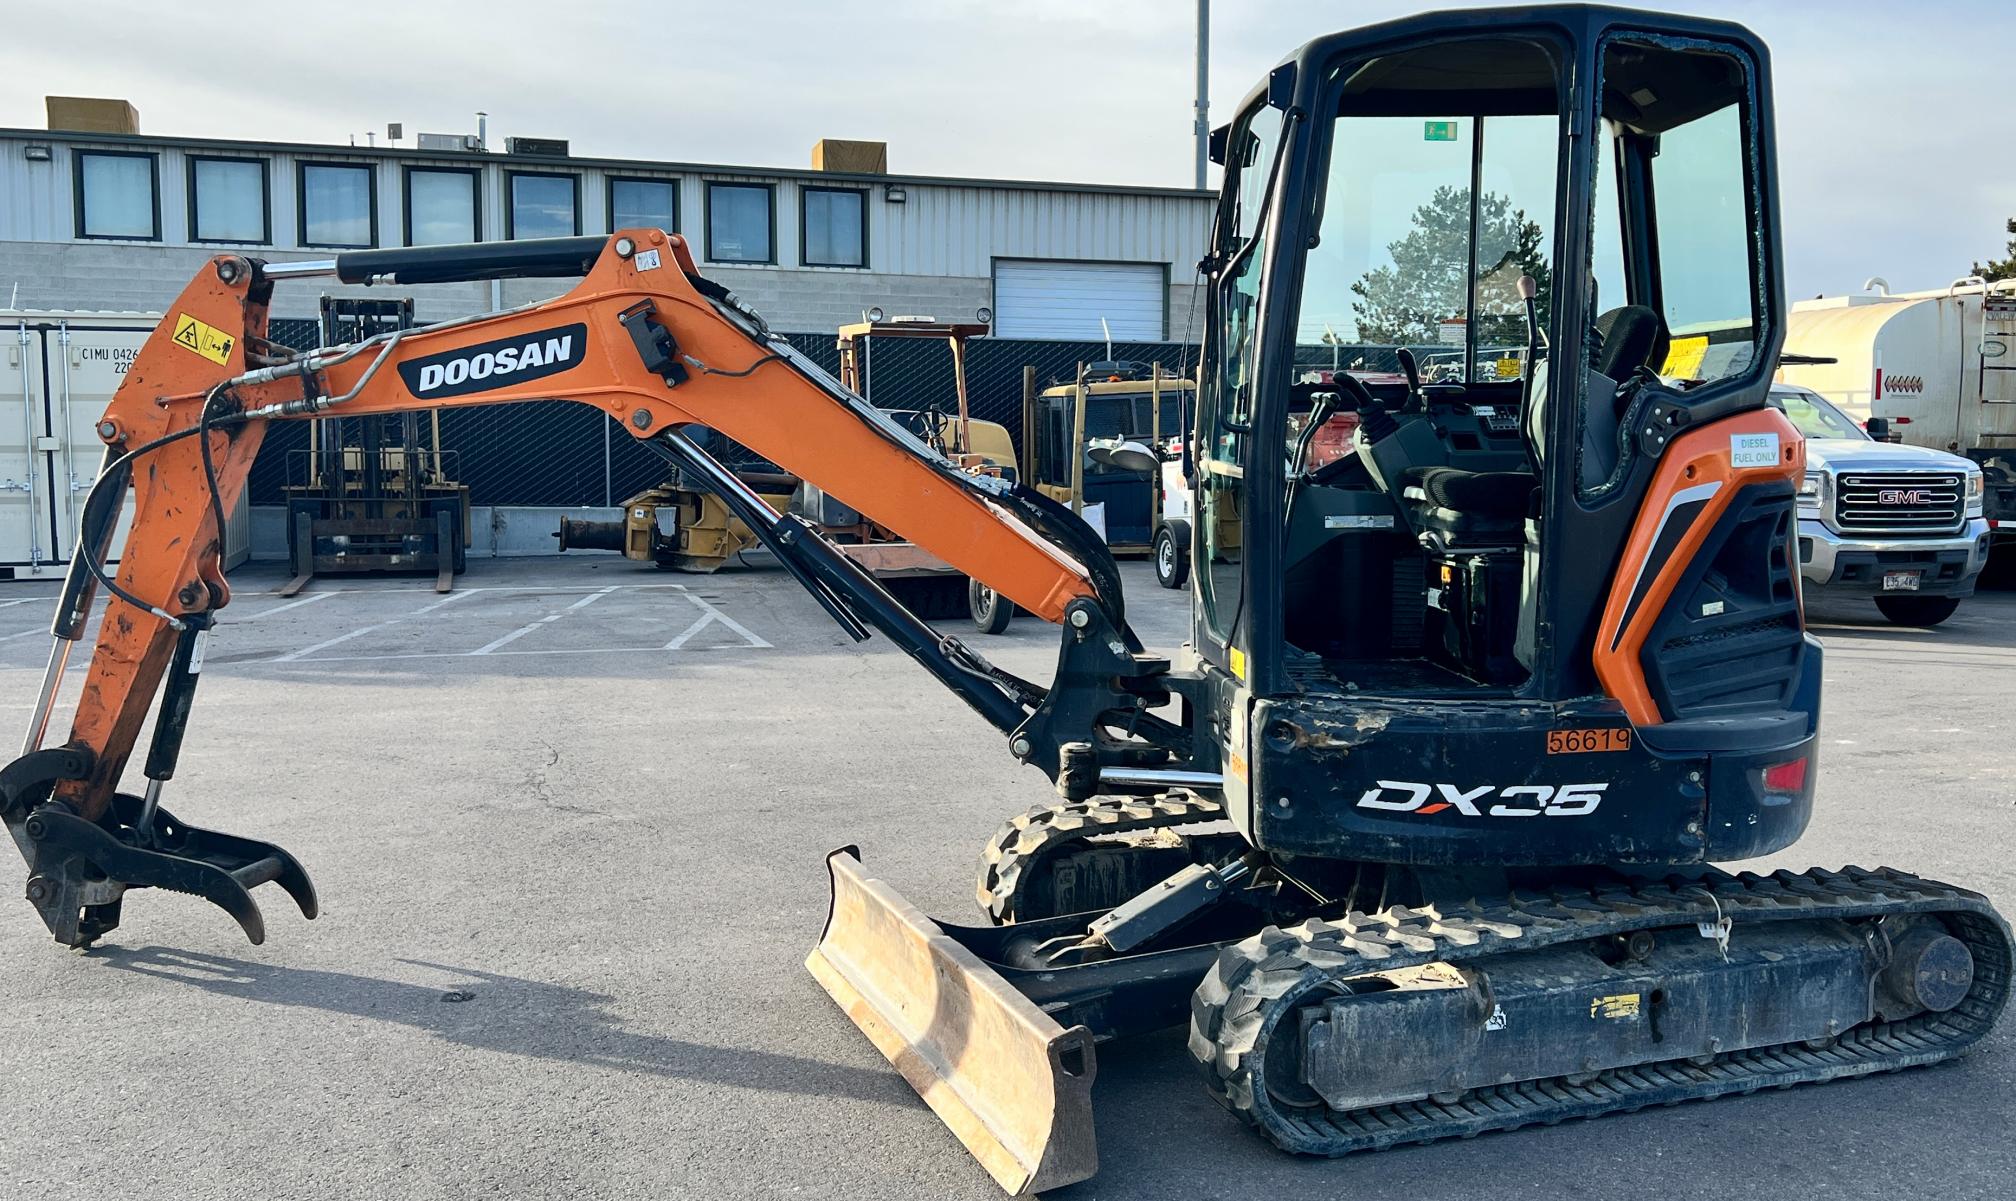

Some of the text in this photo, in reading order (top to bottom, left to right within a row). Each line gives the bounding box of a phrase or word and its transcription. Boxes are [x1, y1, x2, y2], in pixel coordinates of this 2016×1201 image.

[82, 348, 109, 360] CIMU
[419, 335, 572, 392] DOOSAN
[1741, 438, 1769, 449] DIESEL
[1734, 451, 1777, 463] FUEL ONLY
[1879, 490, 1931, 504] GMC
[1549, 729, 1630, 753] 56619
[1356, 780, 1609, 816] DX35
